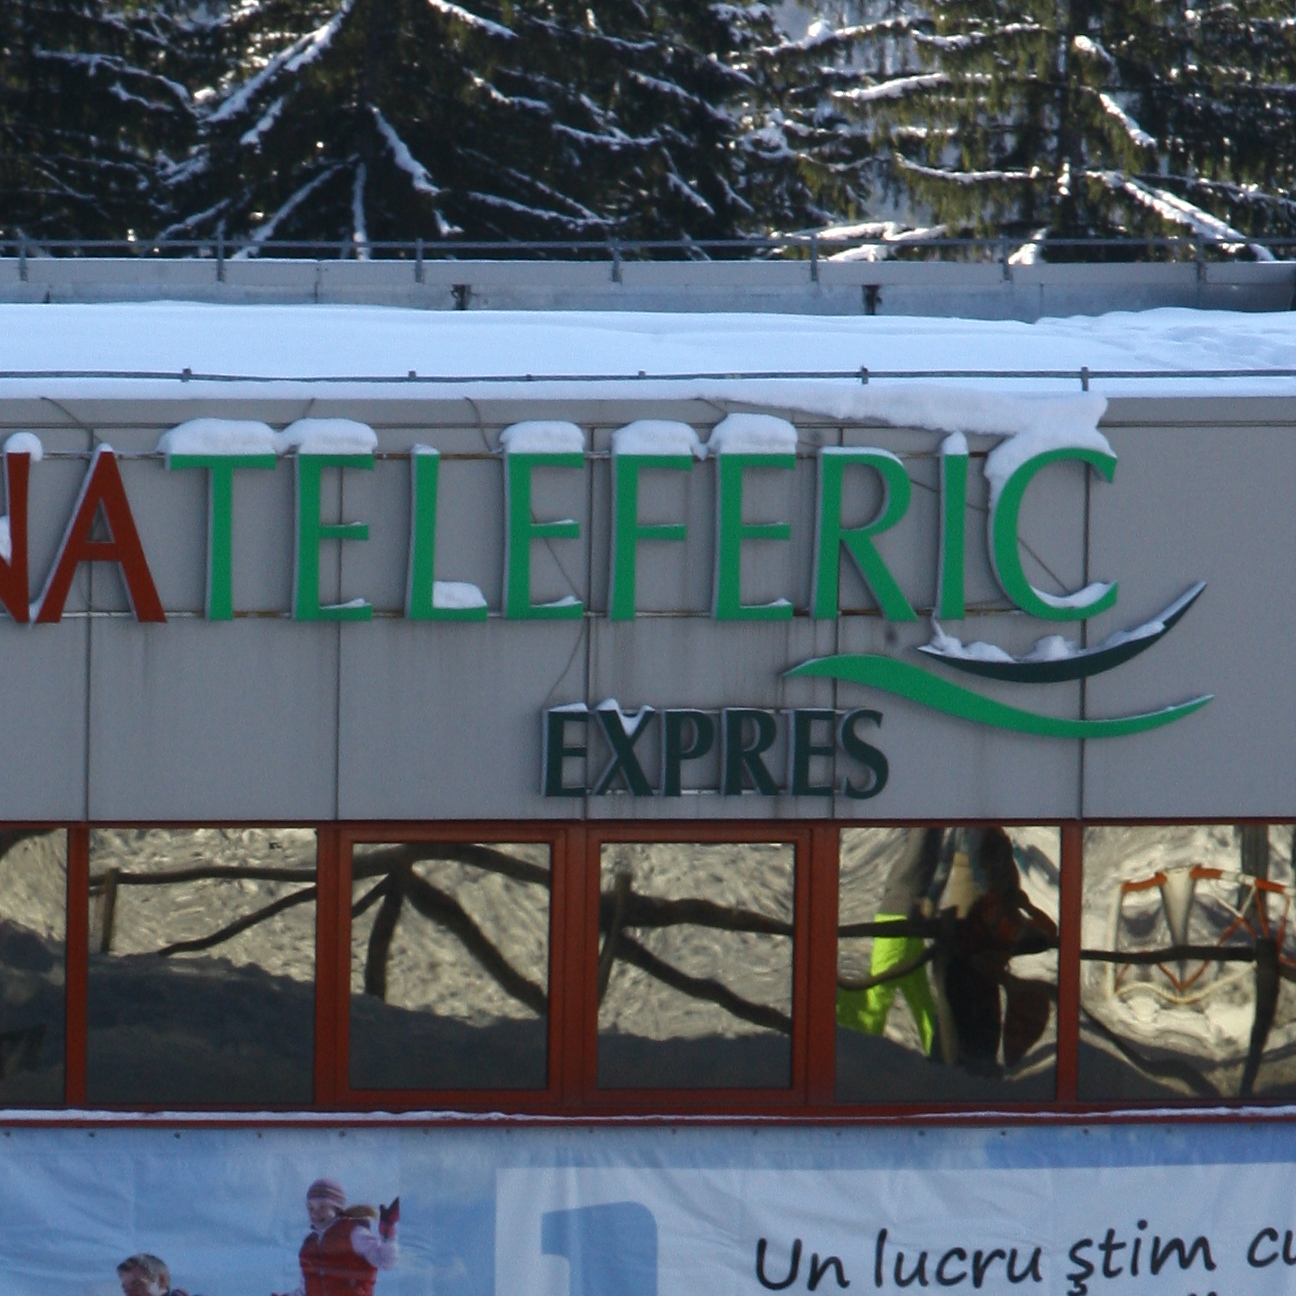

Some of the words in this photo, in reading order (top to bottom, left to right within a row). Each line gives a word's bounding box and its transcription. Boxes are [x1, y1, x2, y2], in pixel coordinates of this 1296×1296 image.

[542, 705, 890, 800] EXPRES
[755, 1237, 851, 1292] Un
[873, 1227, 1044, 1289] lucru
